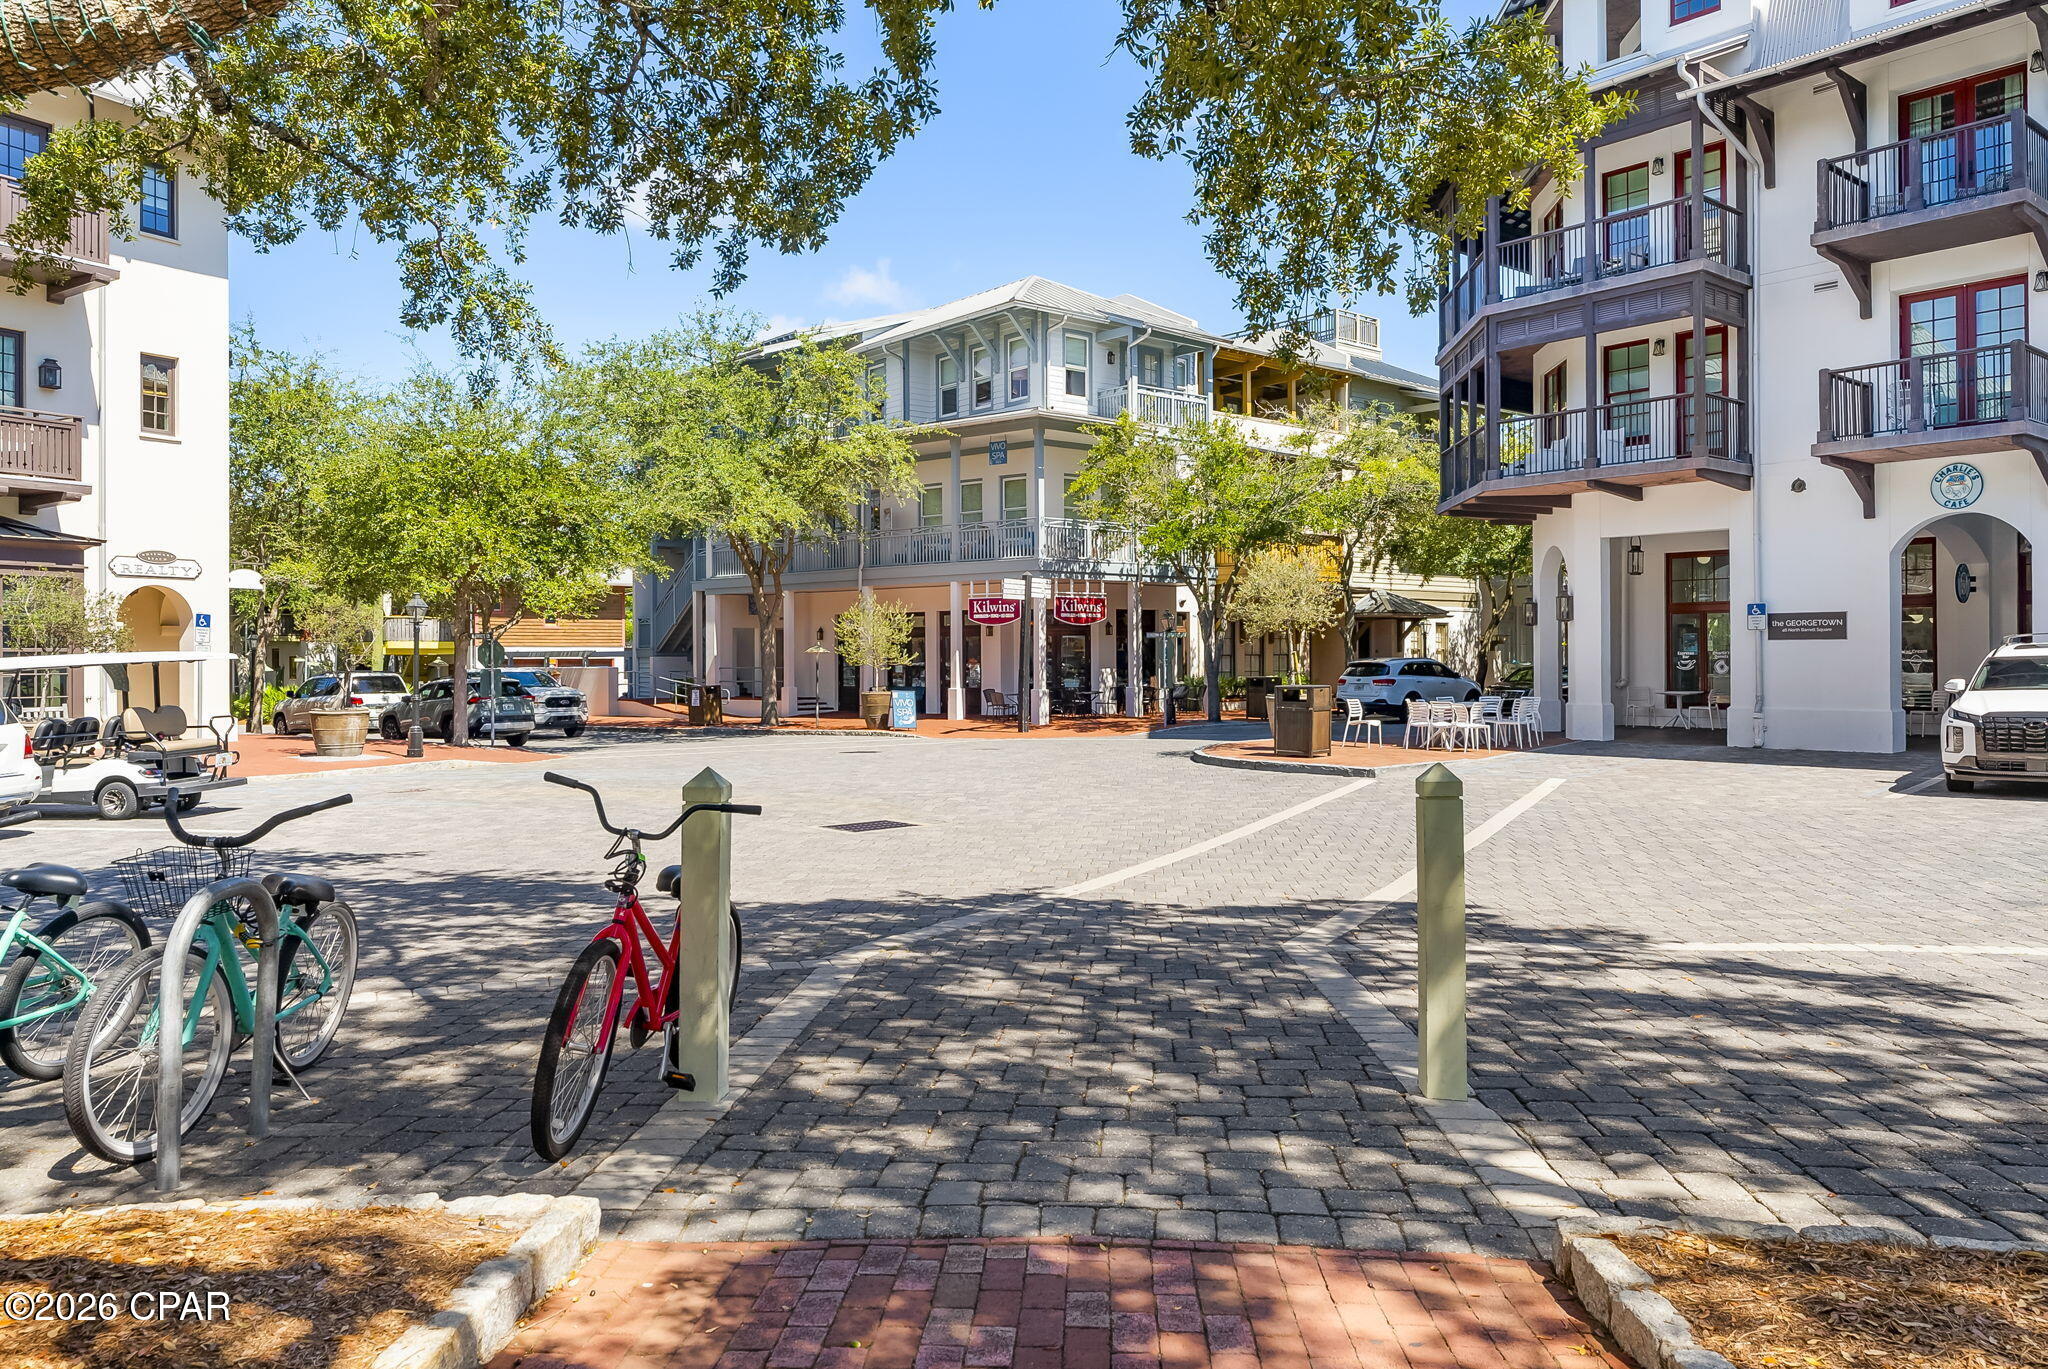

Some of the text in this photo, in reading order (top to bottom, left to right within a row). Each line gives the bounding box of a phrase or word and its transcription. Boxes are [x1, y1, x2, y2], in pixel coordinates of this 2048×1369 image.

[990, 442, 1006, 450] VIVO
[992, 452, 1005, 460] SPA
[1934, 465, 1980, 482] CHARLIE'S
[1944, 498, 1969, 508] CAFE
[120, 564, 192, 576] REALTY
[1786, 619, 1843, 627] GEORGETOWN
[894, 698, 914, 706] VIVO
[896, 708, 912, 717] SPA
